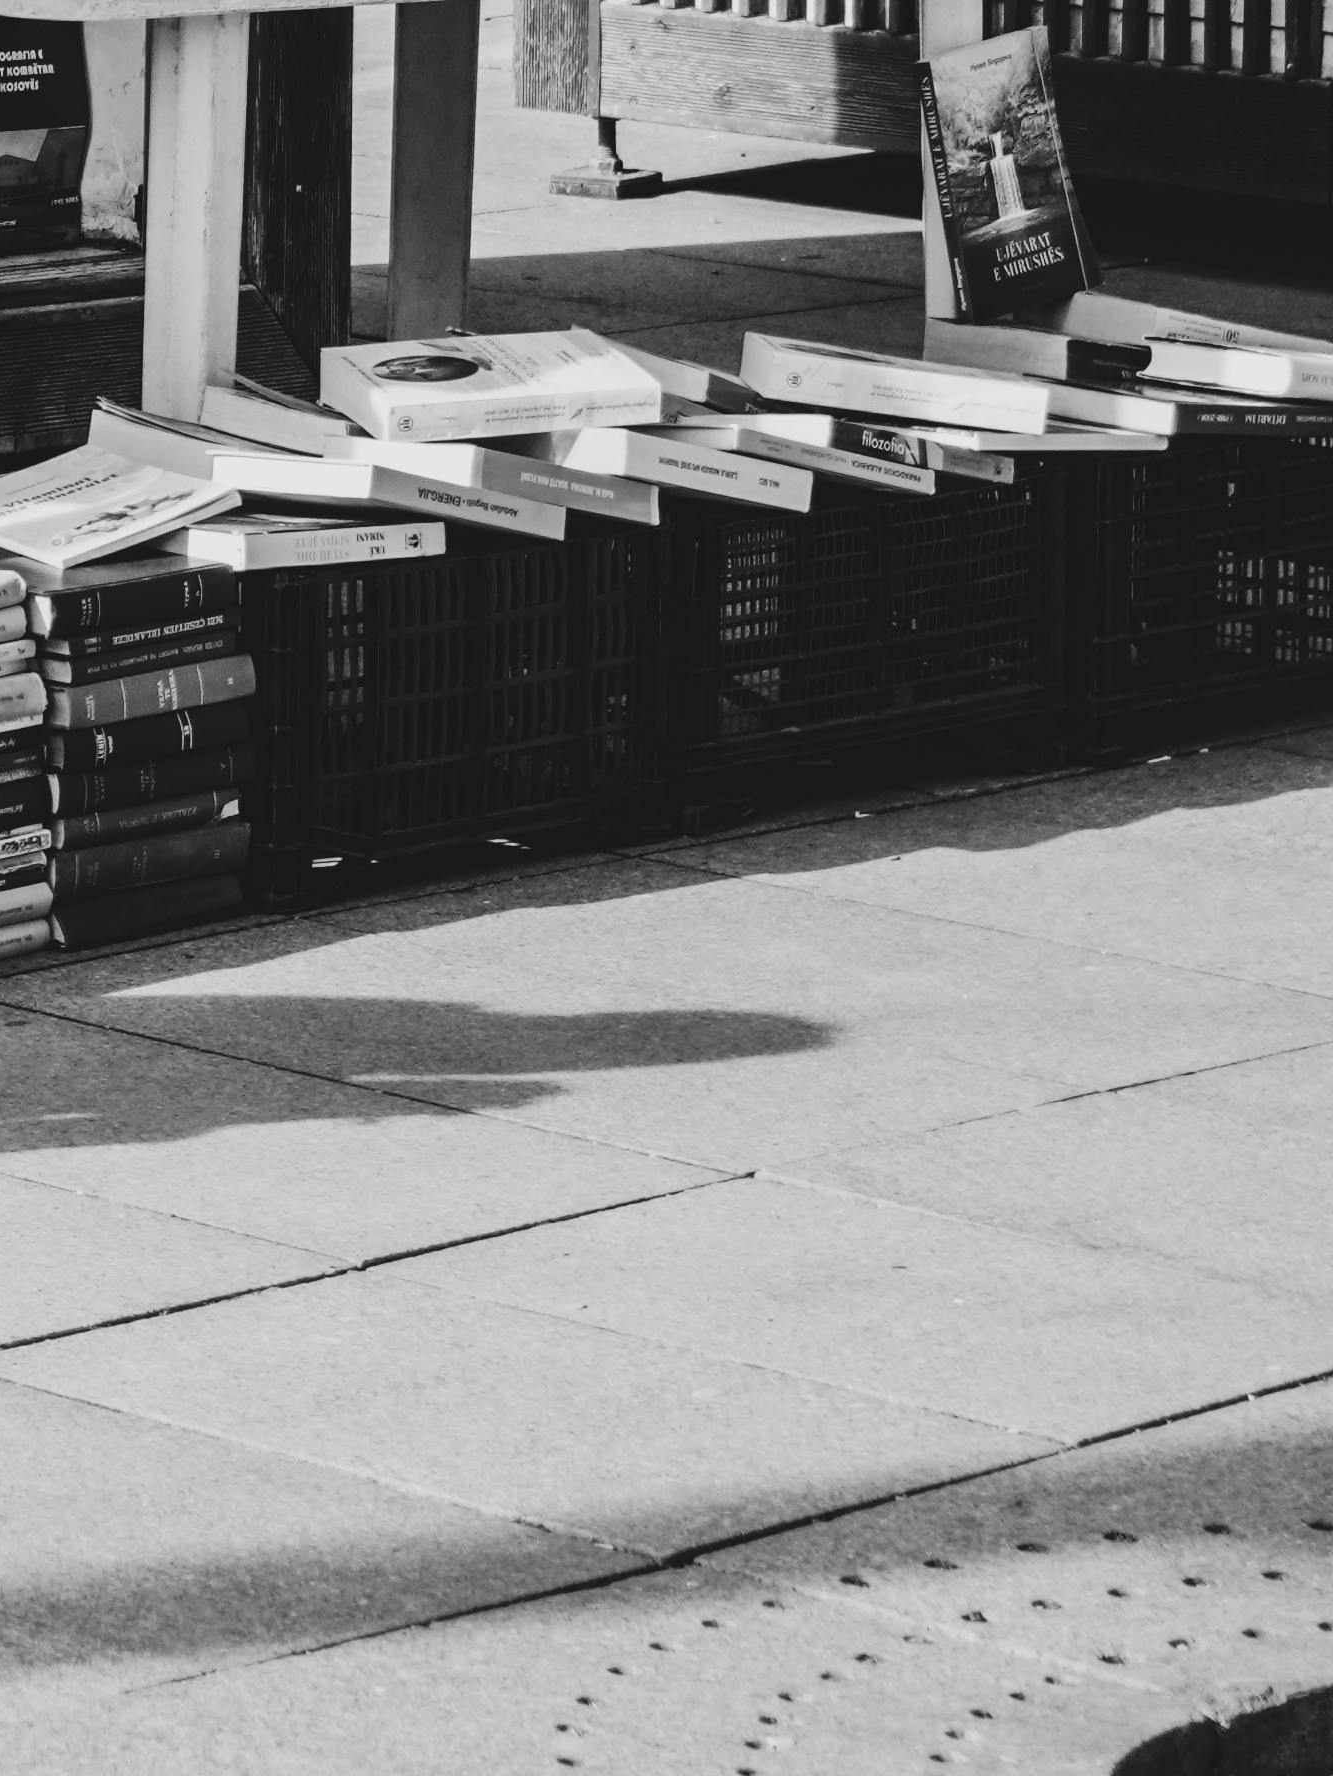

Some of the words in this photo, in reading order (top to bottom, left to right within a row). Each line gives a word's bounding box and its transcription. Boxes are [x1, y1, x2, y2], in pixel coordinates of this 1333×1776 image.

[6, 62, 55, 77] KOMBËTAR
[1, 79, 40, 93] KOSOVËS
[996, 231, 1052, 264] UJËVARAT
[993, 267, 1001, 282] E
[1004, 245, 1065, 278] MIRUSHËS
[861, 430, 906, 457] filozofia
[417, 486, 462, 508] ENERGJIA
